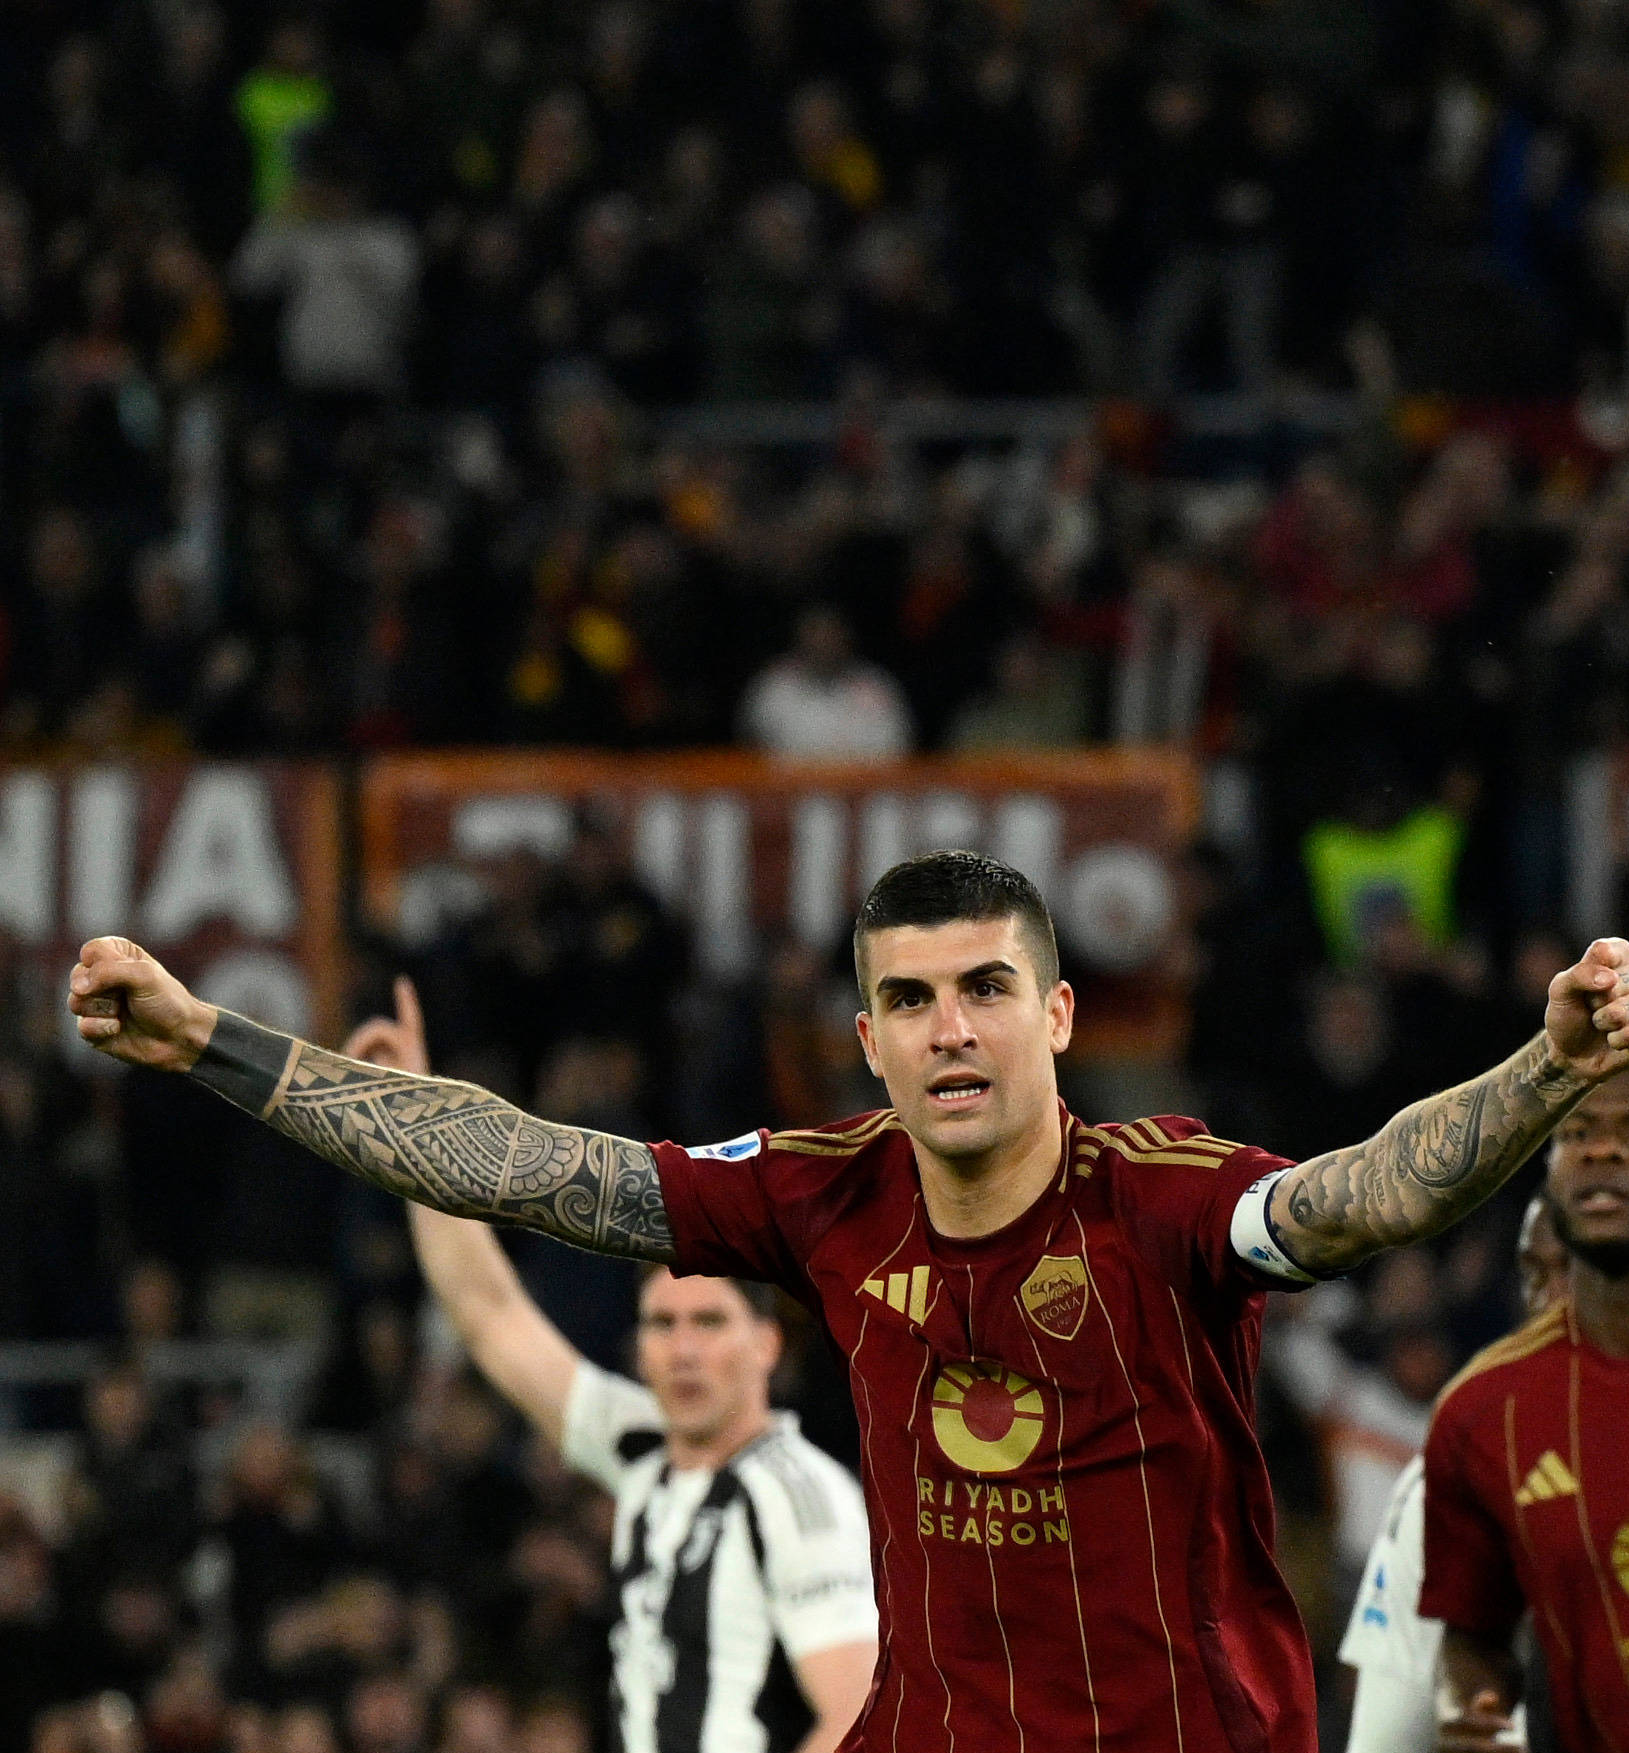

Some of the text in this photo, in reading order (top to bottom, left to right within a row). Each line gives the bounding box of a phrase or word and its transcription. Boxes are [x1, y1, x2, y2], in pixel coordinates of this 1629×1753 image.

[1041, 1296, 1081, 1324] ROMA
[918, 1476, 1064, 1514] RIYADH
[919, 1509, 1069, 1547] SEASON
